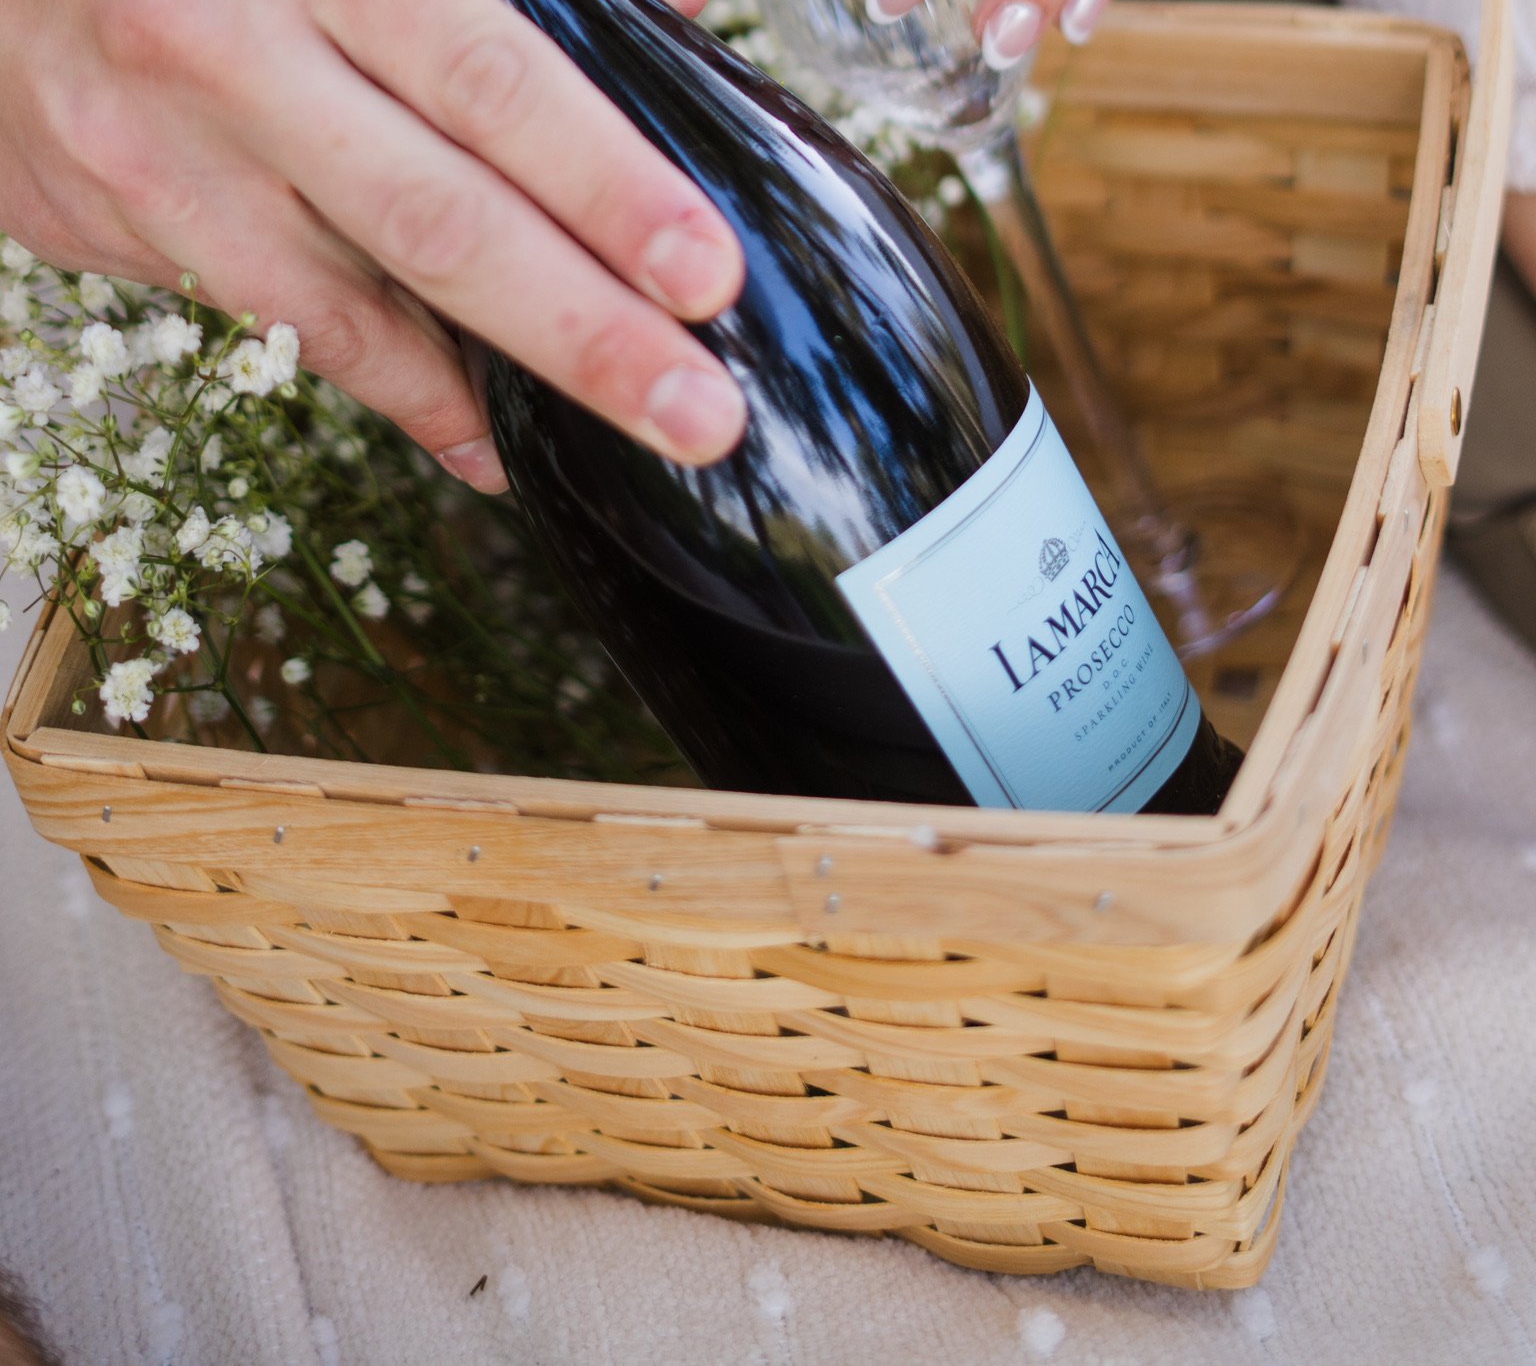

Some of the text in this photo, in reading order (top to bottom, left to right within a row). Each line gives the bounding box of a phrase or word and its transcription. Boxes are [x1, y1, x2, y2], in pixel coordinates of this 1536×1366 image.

[1046, 603, 1136, 713] PROSECCO
[1074, 673, 1137, 742] SPARKLING
[1107, 729, 1147, 772] PRODUCT
